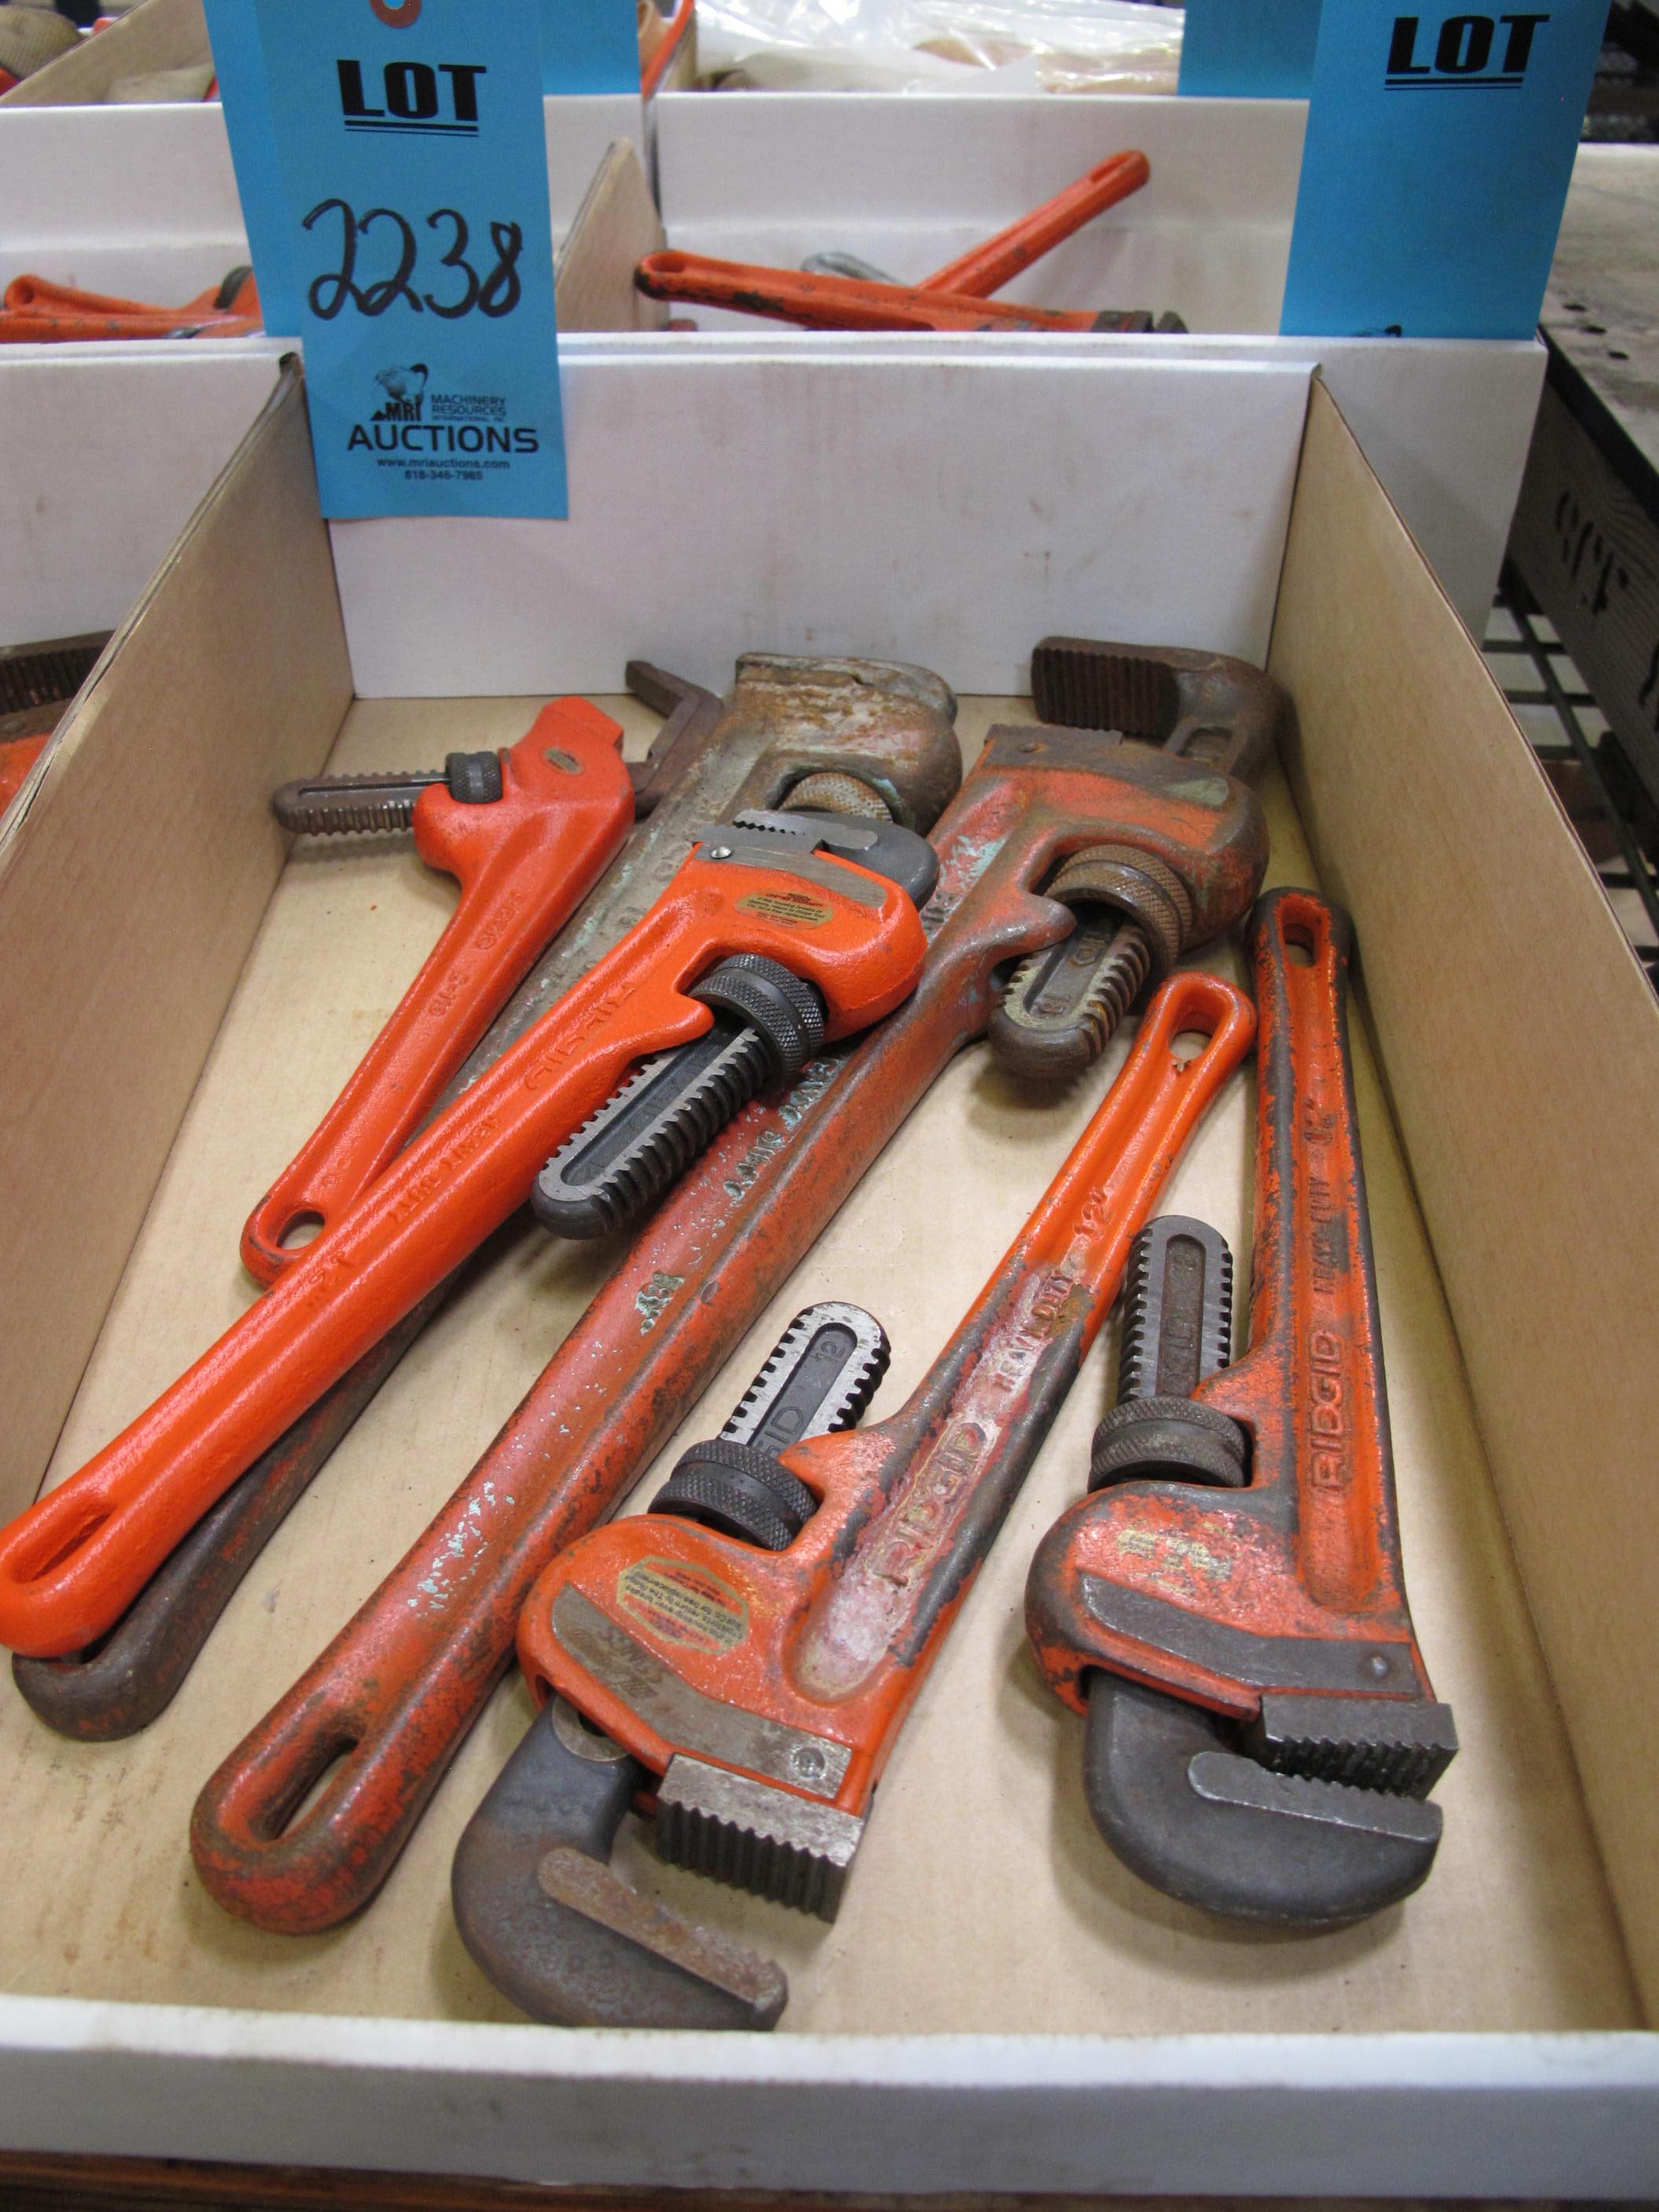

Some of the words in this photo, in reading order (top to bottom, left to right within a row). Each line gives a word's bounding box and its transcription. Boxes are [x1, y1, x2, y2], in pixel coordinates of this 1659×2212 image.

[1386, 14, 1551, 75] LOT
[337, 59, 487, 122] LOT
[302, 198, 523, 320] 2238
[431, 394, 506, 405] MACHINERY
[431, 405, 507, 416] RESOURCES
[347, 423, 539, 452] AUCTIONS
[376, 458, 510, 469] www.mriauctions.com
[1309, 1329, 1352, 1490] RIDGID
